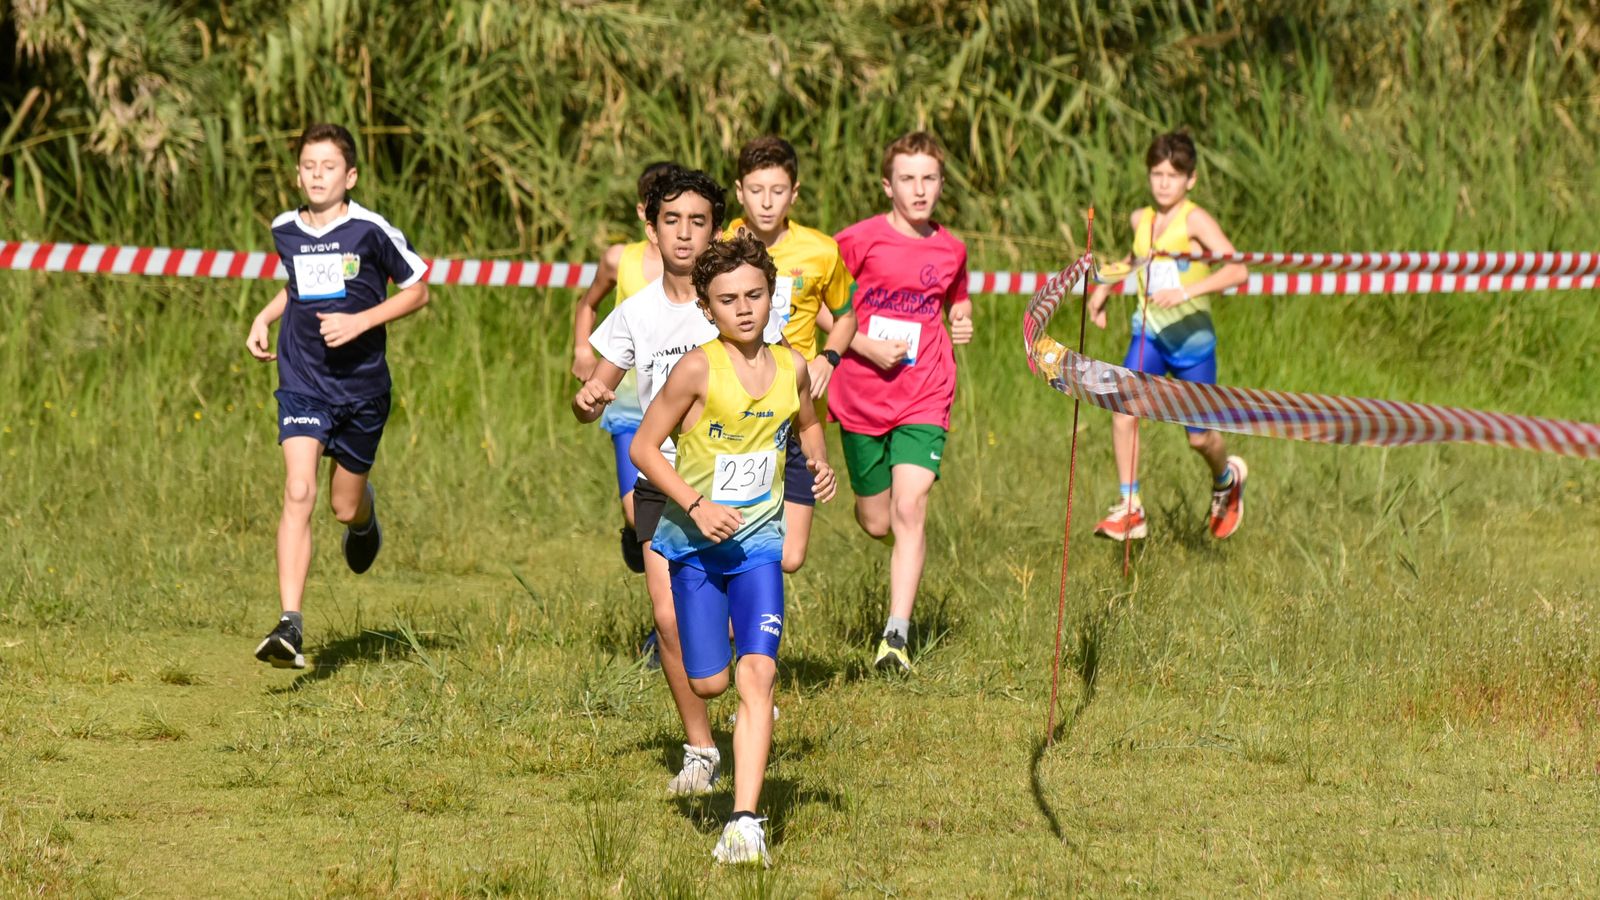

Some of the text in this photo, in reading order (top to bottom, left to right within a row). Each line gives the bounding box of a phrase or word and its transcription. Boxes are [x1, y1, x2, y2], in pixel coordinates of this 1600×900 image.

[300, 242, 340, 253] GIVOVA
[304, 262, 339, 289] 386
[864, 287, 936, 305] ATLETISMO
[283, 415, 321, 427] GIVOVA
[720, 456, 768, 491] 231
